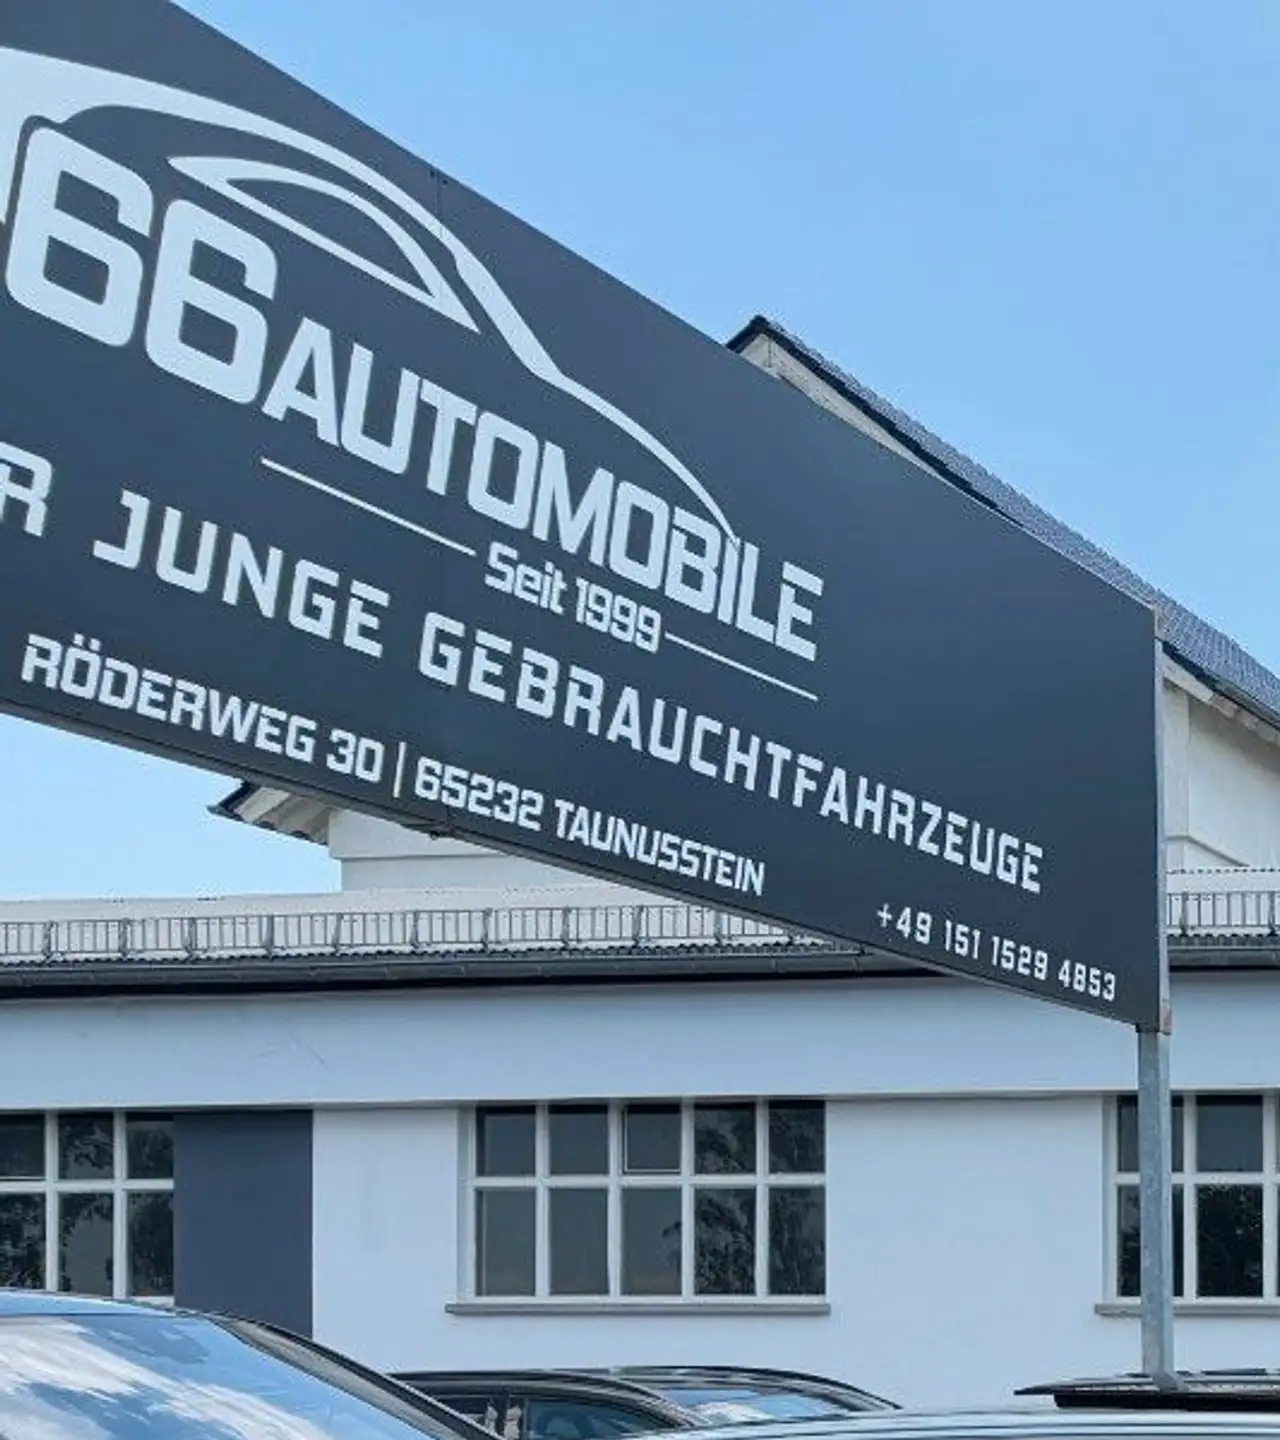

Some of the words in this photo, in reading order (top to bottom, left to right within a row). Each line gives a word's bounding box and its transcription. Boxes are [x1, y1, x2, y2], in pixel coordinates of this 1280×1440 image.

[485, 541, 567, 615] Seit
[575, 577, 662, 654] 1999
[21, 633, 317, 763] RÖDERWEG
[326, 728, 386, 783] 30
[414, 756, 544, 833] 65232
[554, 799, 766, 896] TAUNUSSTEIN
[93, 489, 390, 657] JUNGE
[419, 611, 1043, 895] GEBRAUCHTFAHRZEUGE
[877, 903, 932, 945] +49
[944, 919, 982, 960] 151
[991, 935, 1049, 981] 1529
[1057, 958, 1116, 1002] 4853
